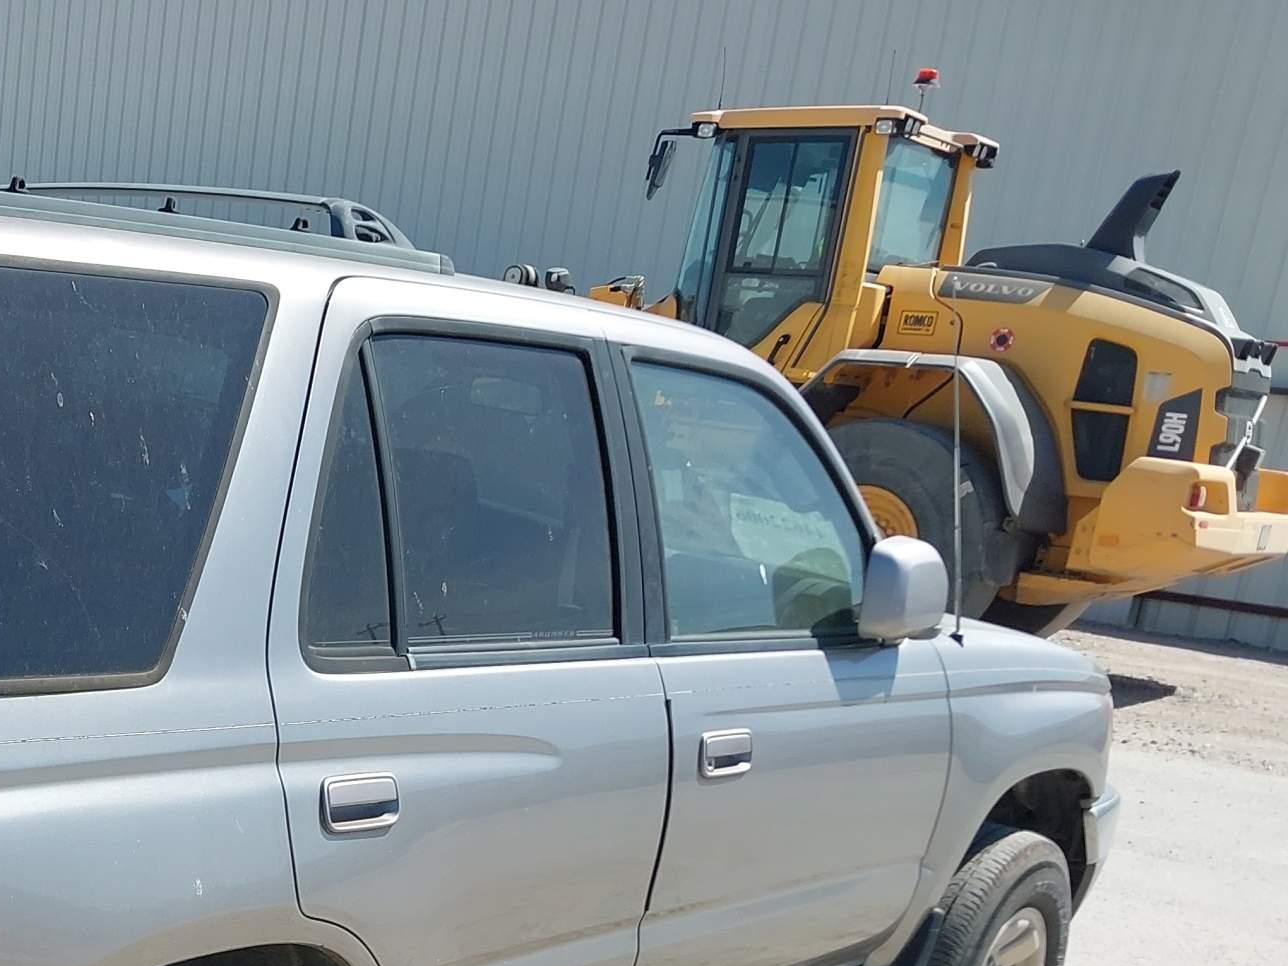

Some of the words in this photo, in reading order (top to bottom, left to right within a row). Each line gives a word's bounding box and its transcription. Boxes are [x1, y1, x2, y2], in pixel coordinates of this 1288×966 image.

[954, 280, 1034, 297] VOLVO
[903, 314, 934, 328] ROMCO
[1156, 412, 1188, 452] L90H
